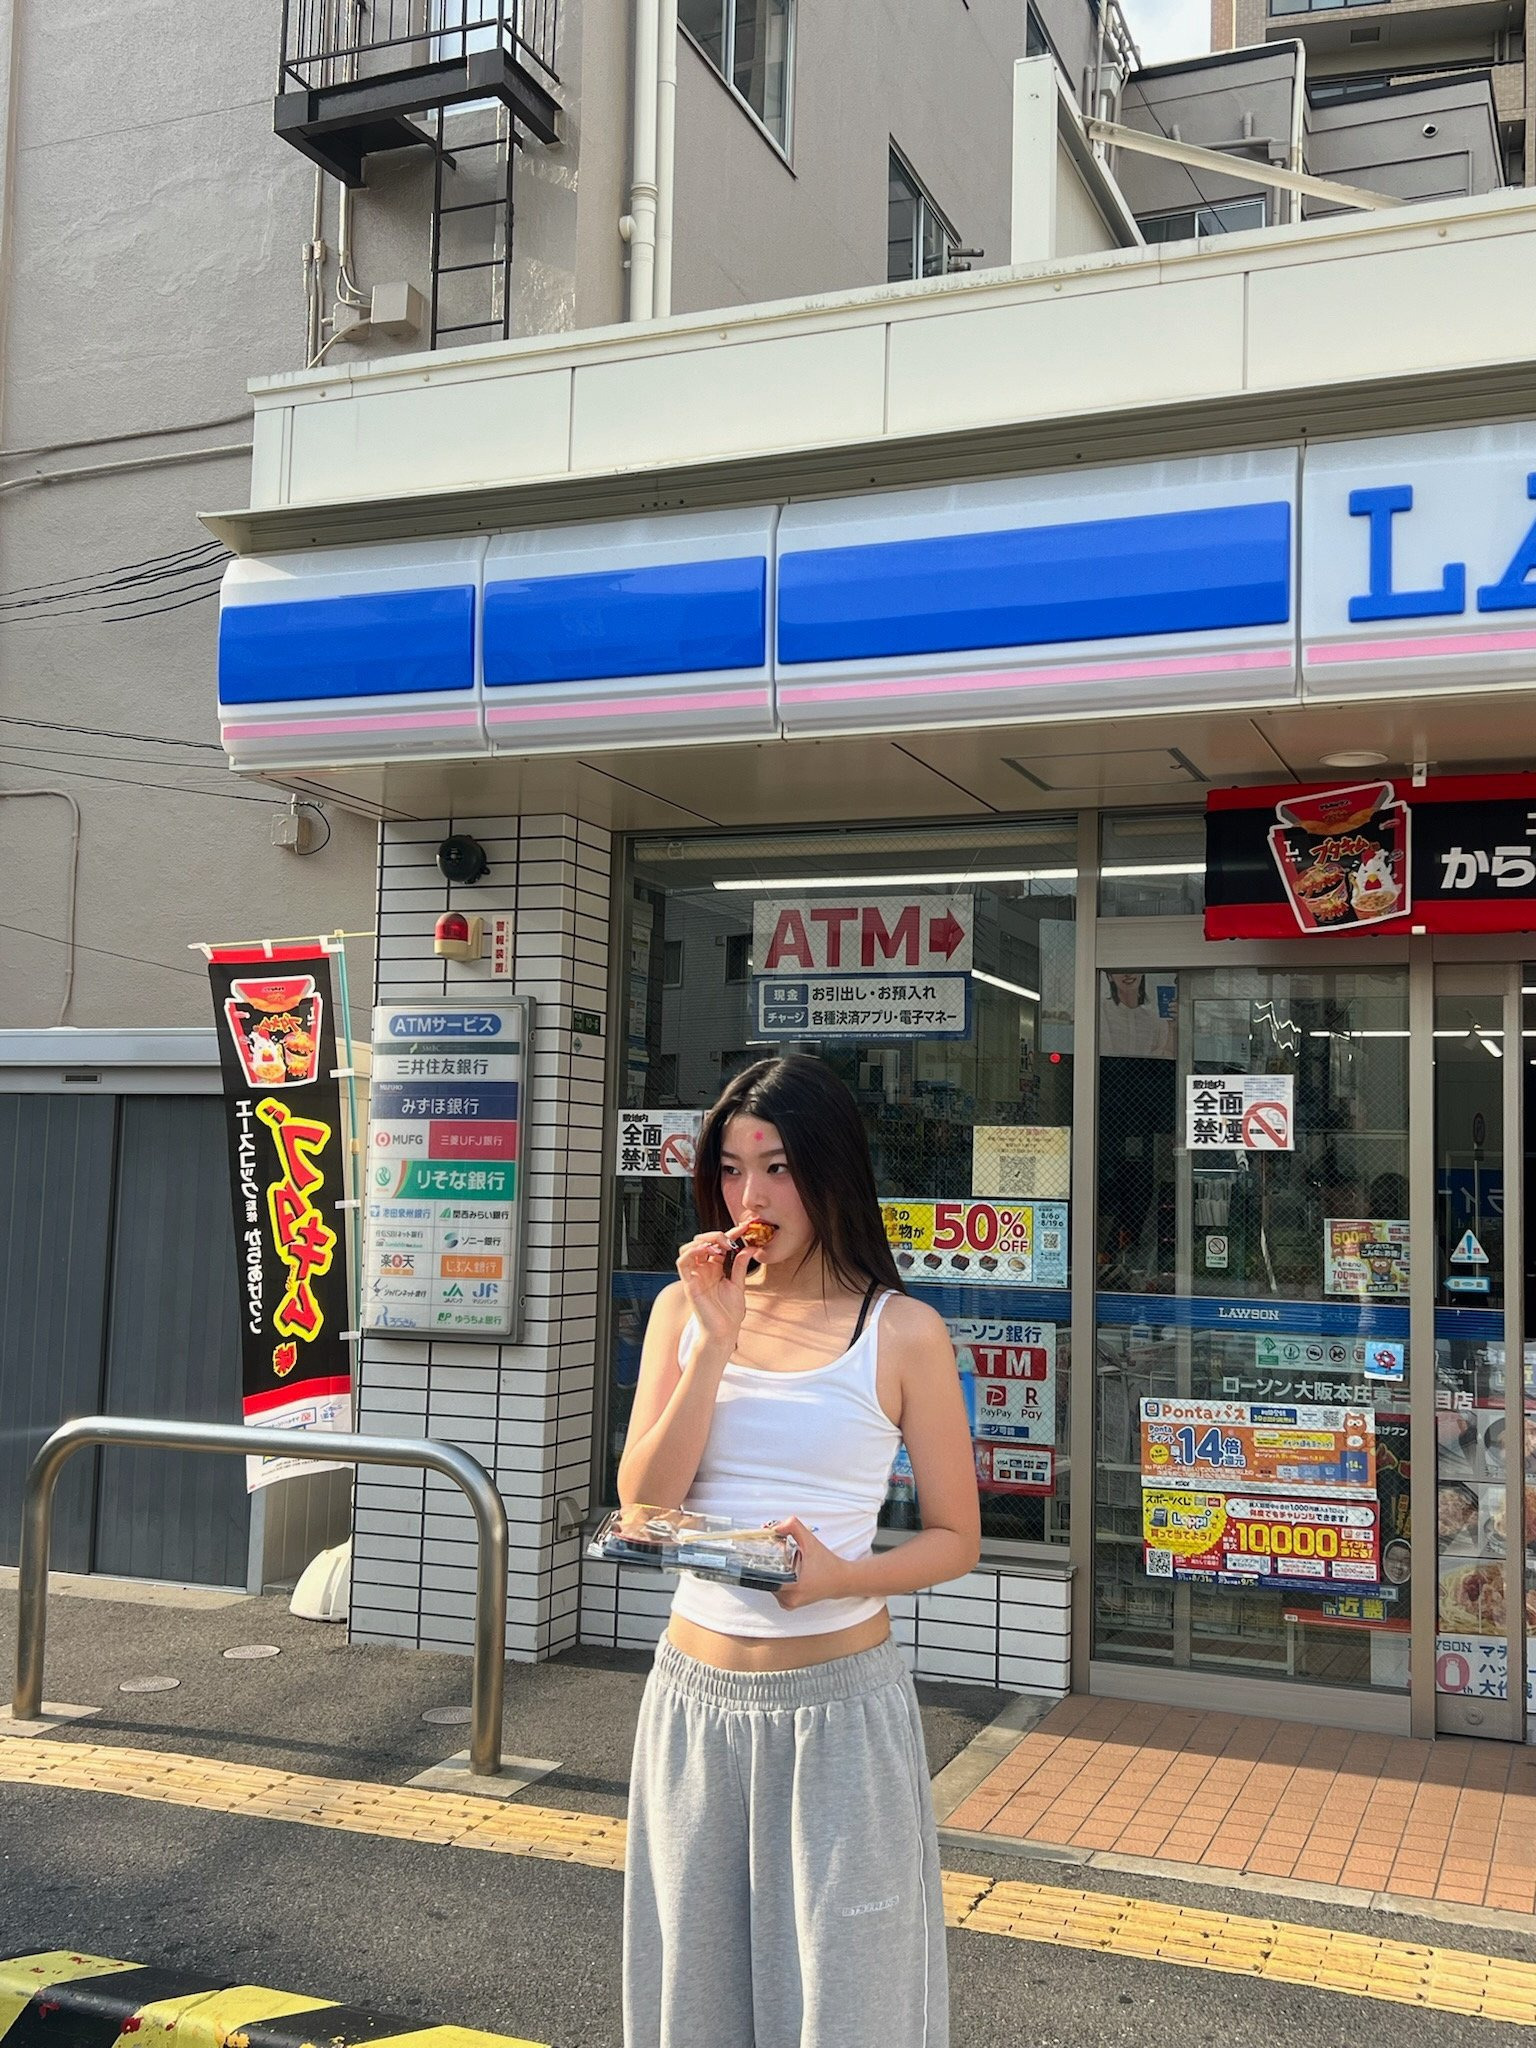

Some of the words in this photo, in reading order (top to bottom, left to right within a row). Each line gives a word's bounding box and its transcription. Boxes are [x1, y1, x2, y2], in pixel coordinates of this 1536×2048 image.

[1440, 846, 1536, 889] から
[764, 905, 921, 968] ATM
[496, 921, 504, 973] 警報装置
[773, 988, 799, 1000] 現金
[812, 985, 936, 1001] お引出し・お預入れ
[394, 1017, 494, 1033] ATMサービス
[767, 1011, 805, 1023] チャージ
[812, 1009, 957, 1025] 各種決済アプリ・電子マネー
[396, 1058, 489, 1075] 三井住友銀行
[401, 1098, 479, 1115] みずほ銀行
[1193, 1091, 1243, 1116] 全面
[392, 1134, 423, 1144] MUFG
[622, 1123, 662, 1146] 全面
[1193, 1118, 1243, 1144] 禁煙
[440, 1135, 503, 1146] 三菱UFJ銀行
[621, 1148, 661, 1171] 禁煙
[417, 1169, 505, 1191] りそな銀行
[453, 1209, 509, 1220] 関西みらい銀行
[933, 1202, 1025, 1251] 50%
[462, 1236, 501, 1247] ソニー銀行
[1000, 1240, 1028, 1252] OFF
[446, 1260, 496, 1273] じぶん銀行
[443, 1283, 463, 1297] JA
[455, 1315, 502, 1325] ゆうちょ銀行
[1218, 1307, 1280, 1321] LAWSON
[956, 1347, 1031, 1377] ATM
[981, 1408, 1012, 1418] PayPay
[1021, 1409, 1042, 1420] Pay
[1162, 1404, 1246, 1421] Pontaパス
[1149, 1425, 1172, 1434] Ponta
[1148, 1434, 1174, 1443] ポイント
[1177, 1426, 1224, 1466] 14
[1223, 1438, 1241, 1455] 倍
[1224, 1455, 1246, 1466] 還元
[1146, 1495, 1191, 1506] スポーツくじ
[1172, 1511, 1208, 1529] Loppi
[1151, 1528, 1212, 1541] 買って当てよう!
[1235, 1522, 1339, 1558] 10,000
